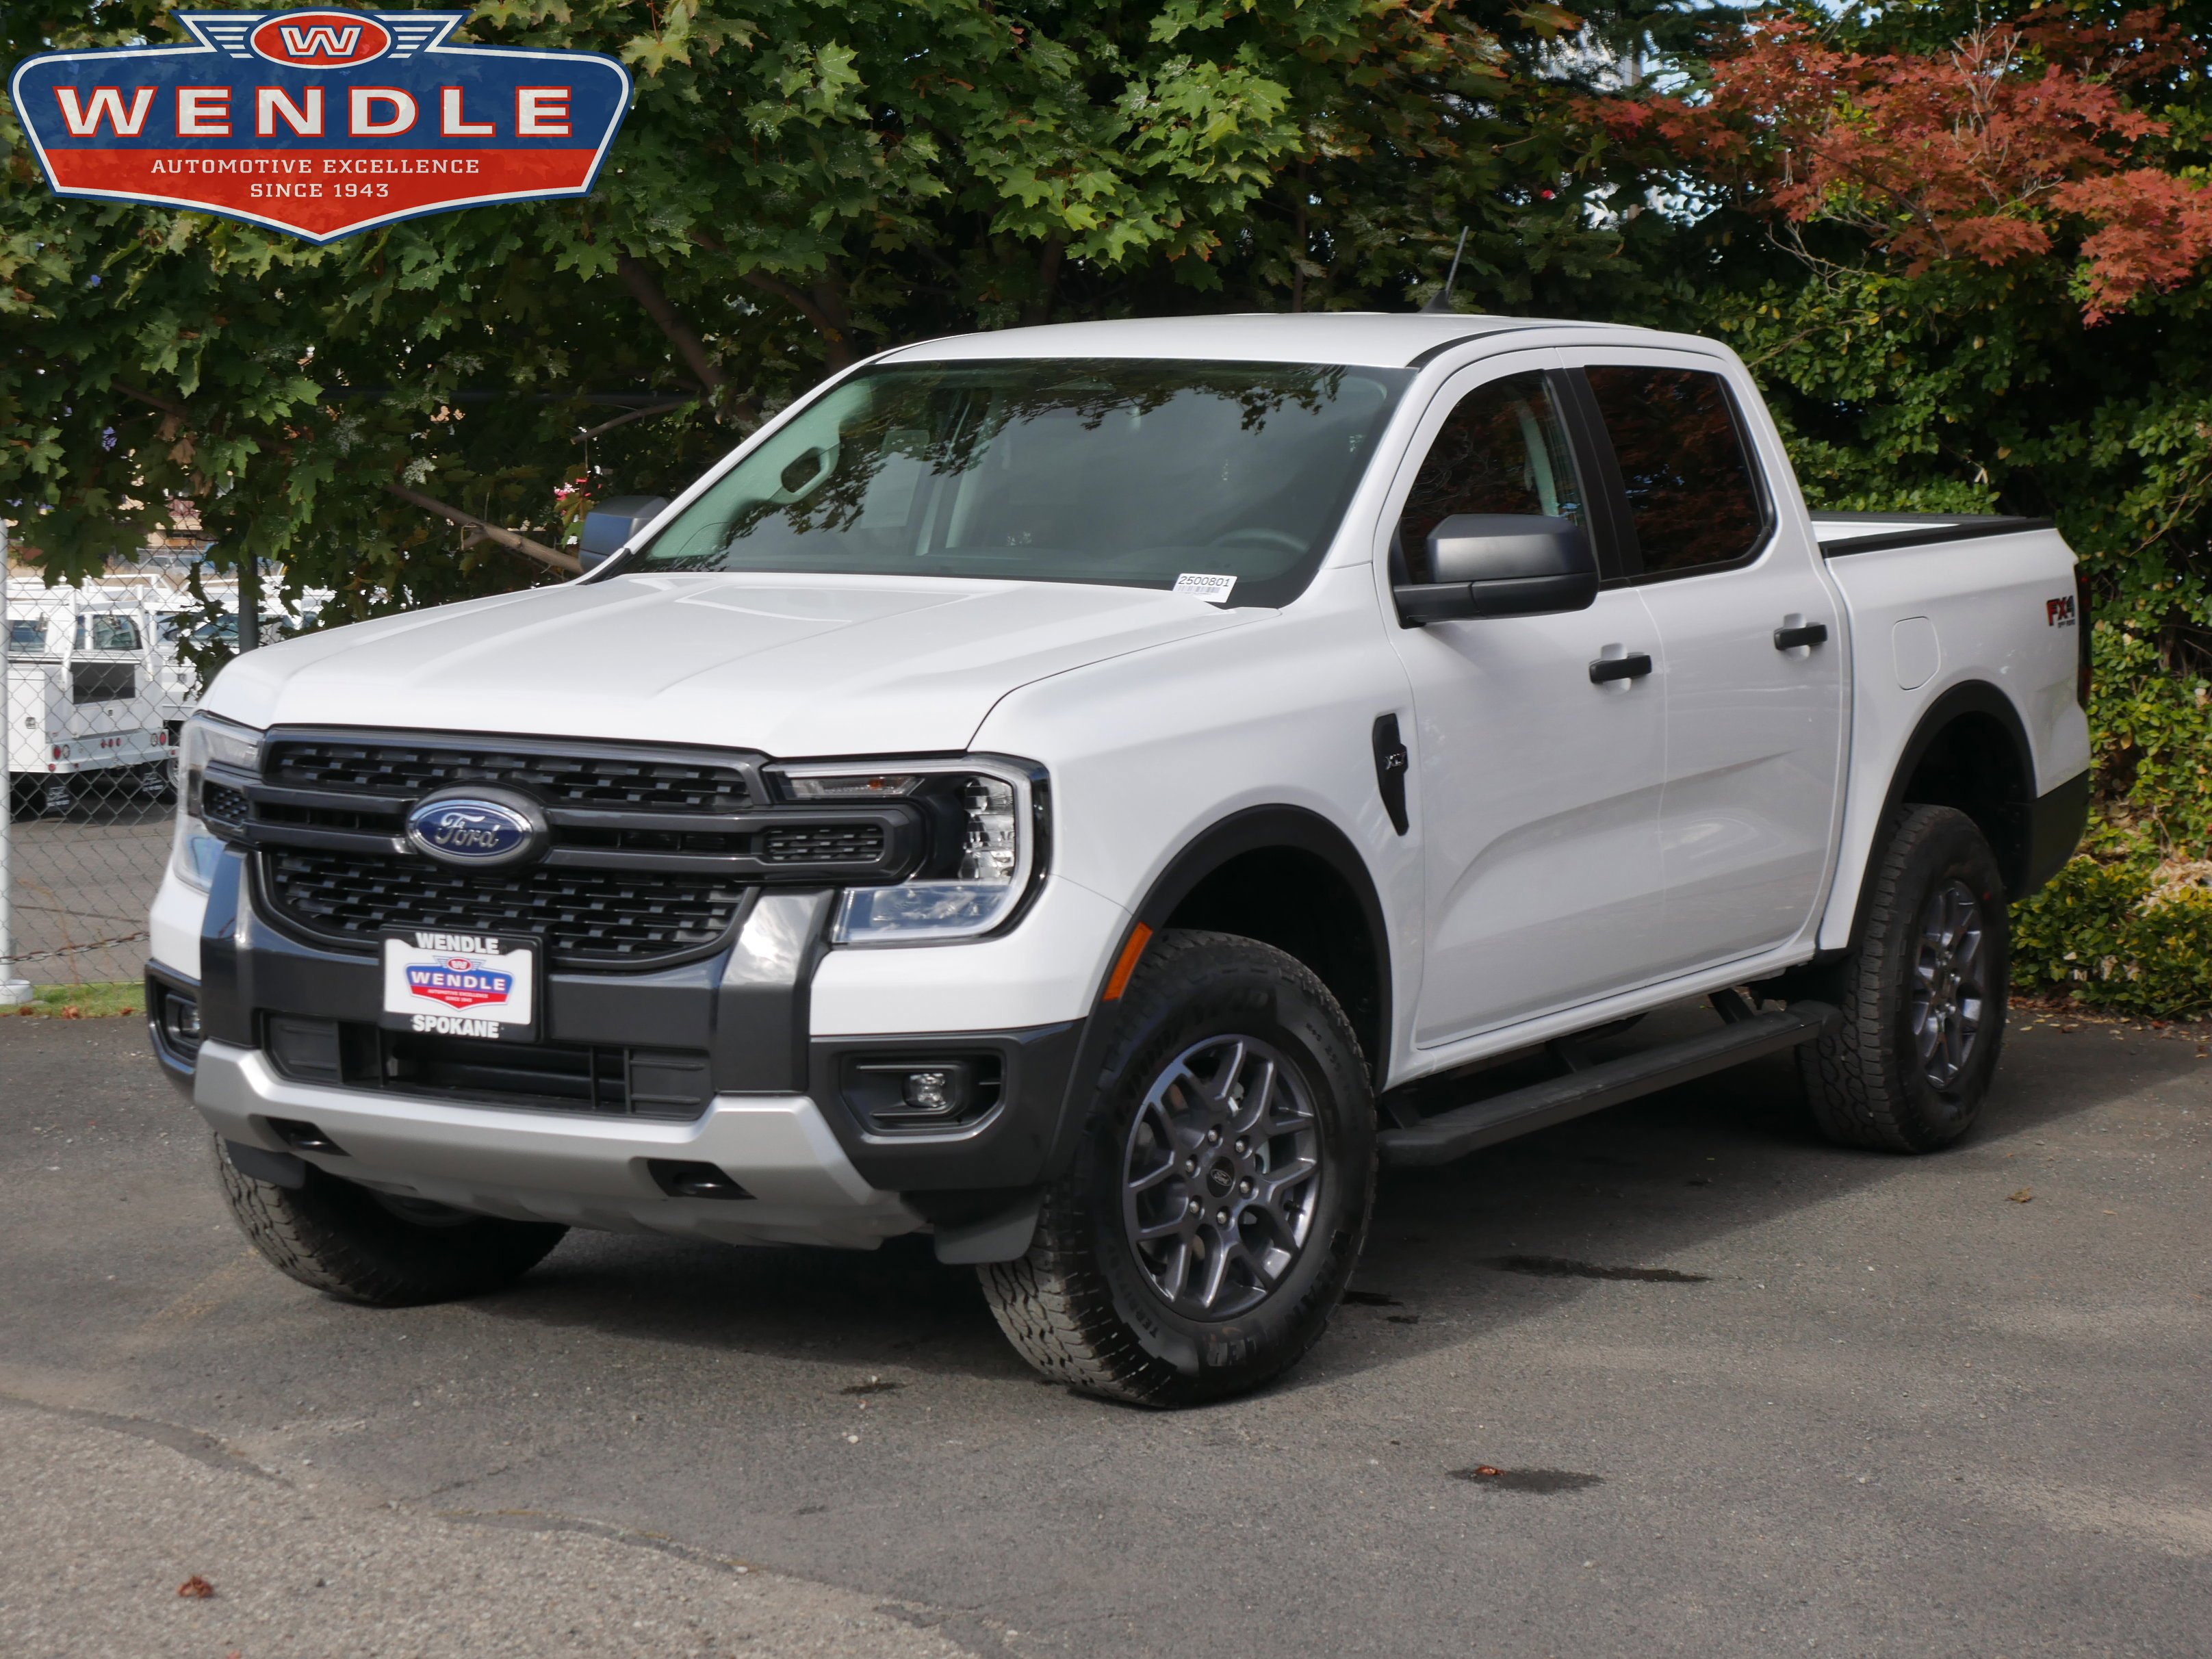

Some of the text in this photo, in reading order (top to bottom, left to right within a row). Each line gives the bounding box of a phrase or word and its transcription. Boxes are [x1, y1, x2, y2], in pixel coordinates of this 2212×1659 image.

[1178, 576, 1231, 587] 2500801
[2046, 595, 2075, 626] FX4
[435, 812, 501, 848] Ford
[415, 932, 500, 955] WENDLE
[411, 970, 506, 992] WENDLE
[413, 1014, 500, 1038] SPOKANE
